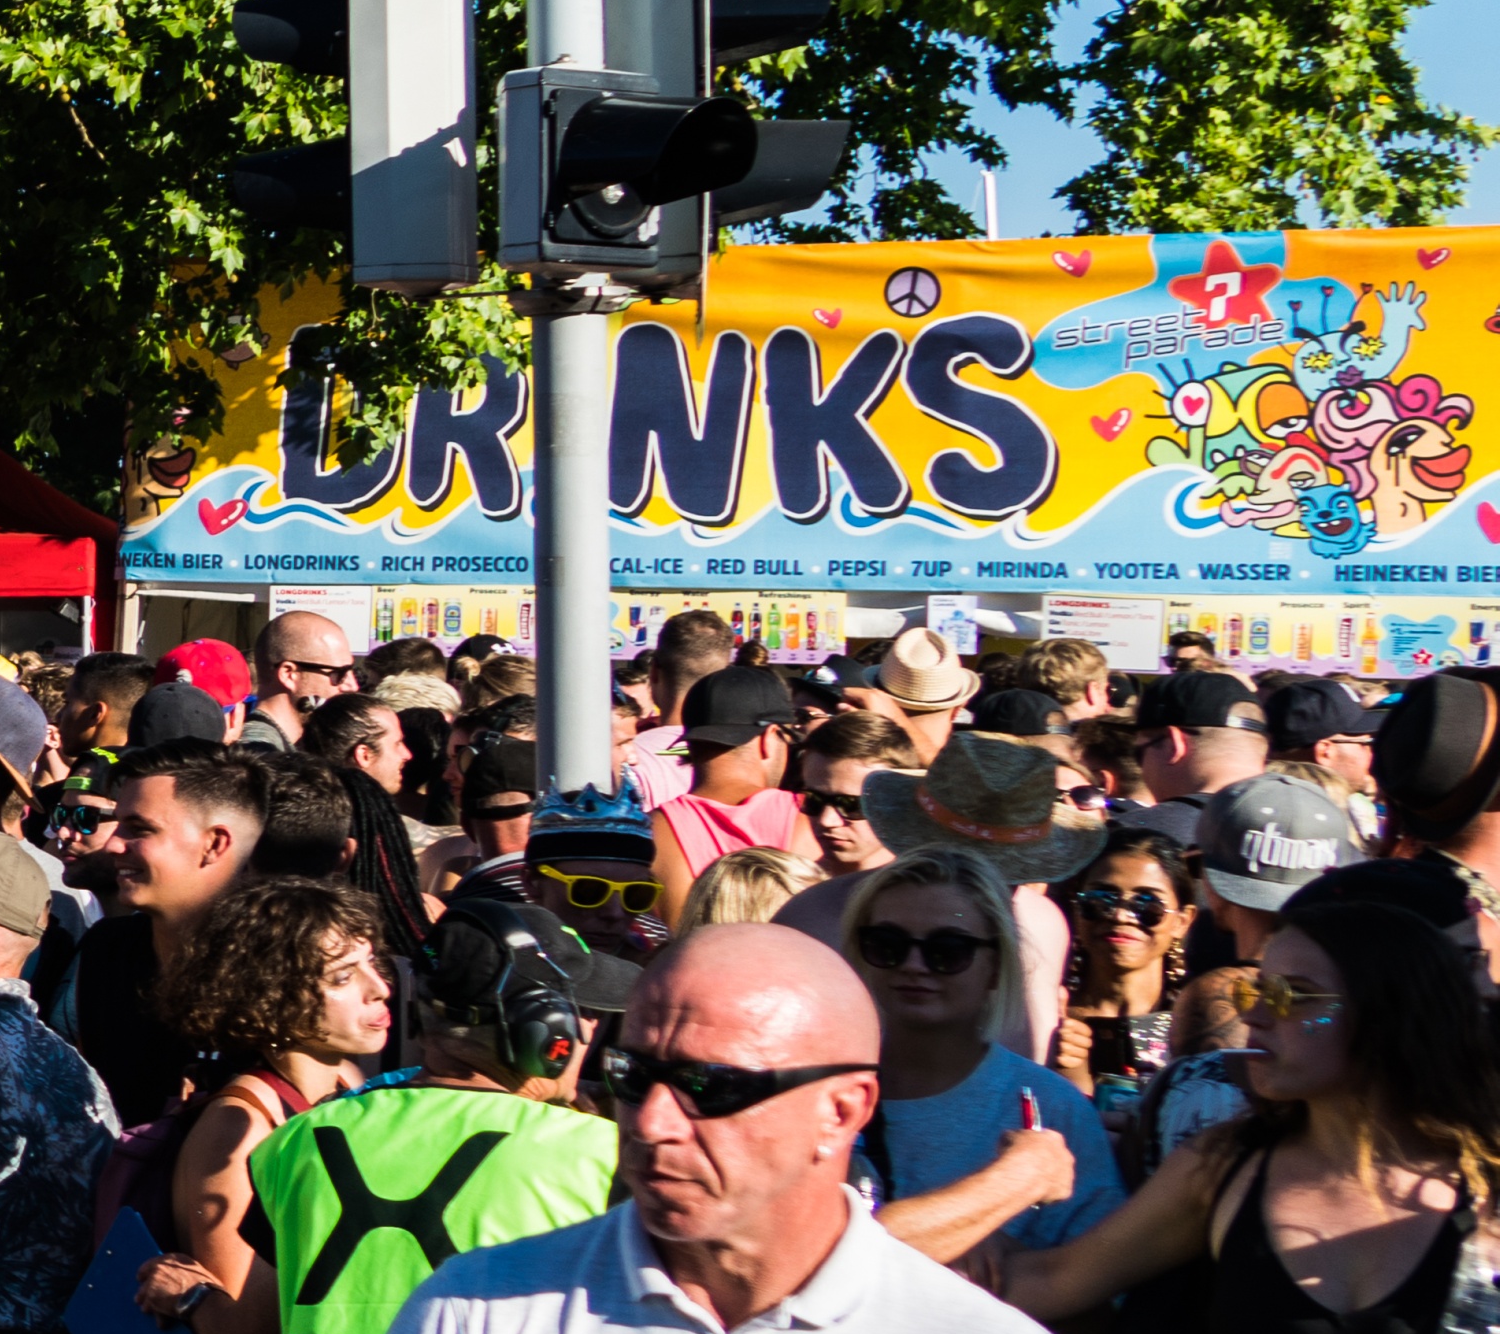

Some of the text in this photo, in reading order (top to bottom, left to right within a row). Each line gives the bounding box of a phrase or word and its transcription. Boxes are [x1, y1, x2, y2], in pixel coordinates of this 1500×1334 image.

[1052, 305, 1208, 349] street
[1123, 319, 1286, 370] parade
[280, 313, 1059, 528] DRNKS
[118, 552, 176, 569] NEKEN
[183, 553, 223, 570] BIER
[245, 555, 360, 571] LONGDRINKS
[381, 556, 425, 572] RICH
[432, 556, 529, 573] PROSECCO
[609, 557, 684, 575] CAL-ICE
[707, 559, 746, 575] RED
[753, 559, 804, 576] BULL
[827, 559, 887, 577] PEPSI
[911, 560, 952, 577] 7UP
[977, 561, 1068, 579] MIRINDA
[1094, 562, 1180, 580] YOOTEA
[1199, 563, 1291, 581] WASSER
[1335, 565, 1448, 583] HEINEKEN
